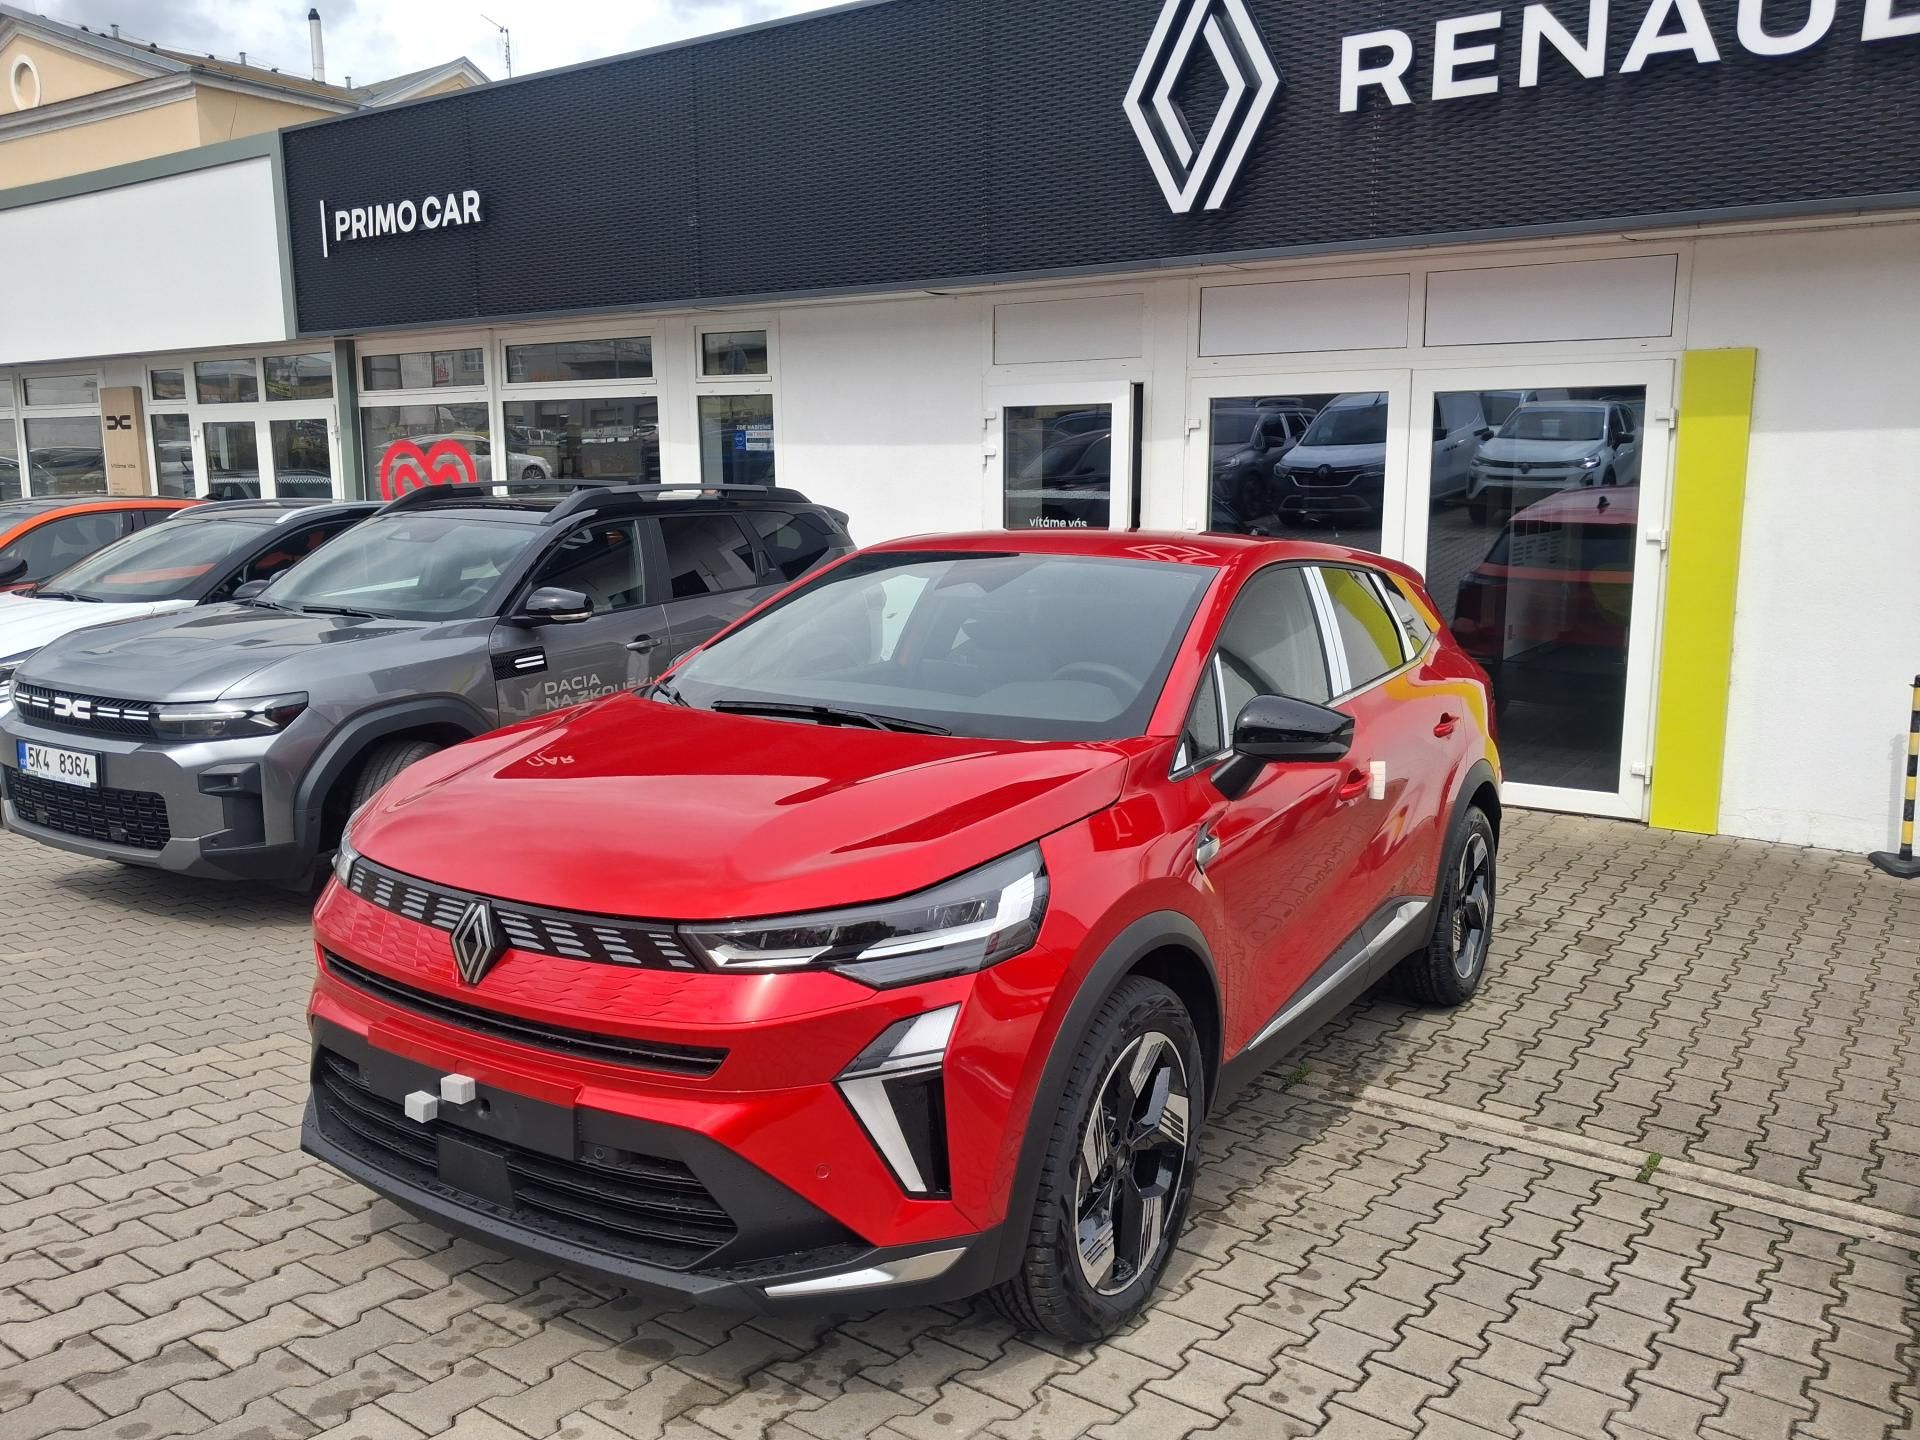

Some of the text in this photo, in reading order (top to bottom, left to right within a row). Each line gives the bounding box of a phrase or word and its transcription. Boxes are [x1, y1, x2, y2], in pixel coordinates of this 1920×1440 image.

[335, 190, 481, 241] PRIMO CAR
[1029, 516, 1088, 528] vítáme vás
[544, 673, 602, 695] DACIA
[545, 694, 573, 711] NA
[28, 746, 90, 779] 5K4 8364
